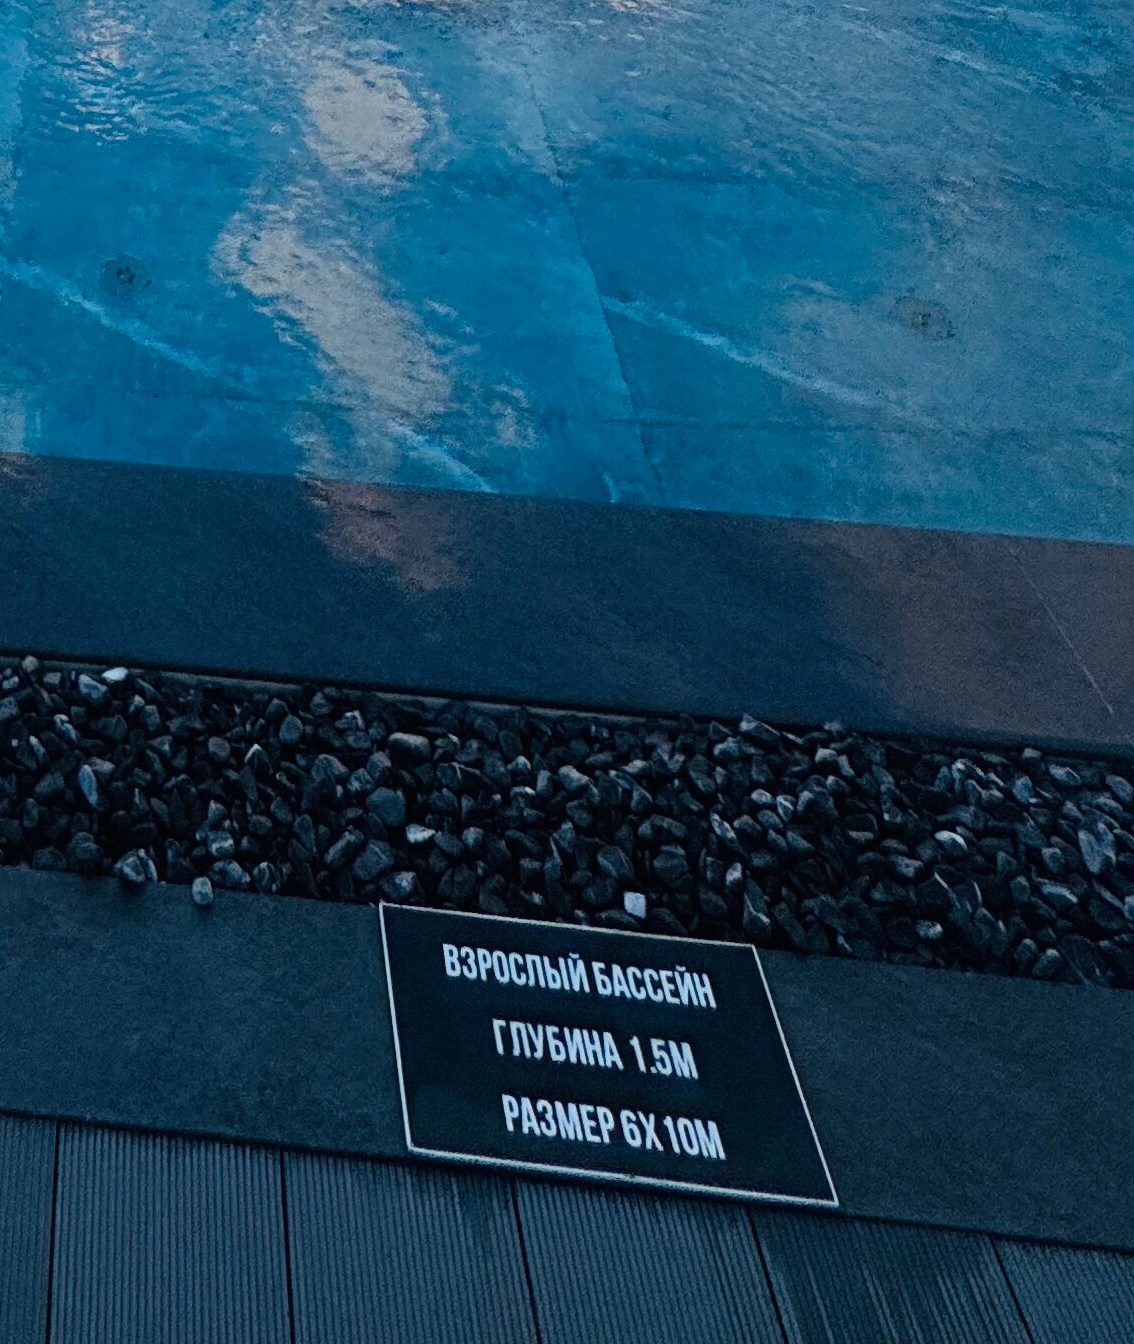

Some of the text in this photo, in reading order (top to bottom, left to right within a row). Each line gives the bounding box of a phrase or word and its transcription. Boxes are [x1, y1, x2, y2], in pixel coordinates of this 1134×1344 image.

[442, 943, 717, 1010] ВЗРОСЛЫЙ БАССЕЙН
[492, 1018, 699, 1080] ГЛУБИНА 1.5М
[501, 1093, 615, 1144] РАЗМЕР
